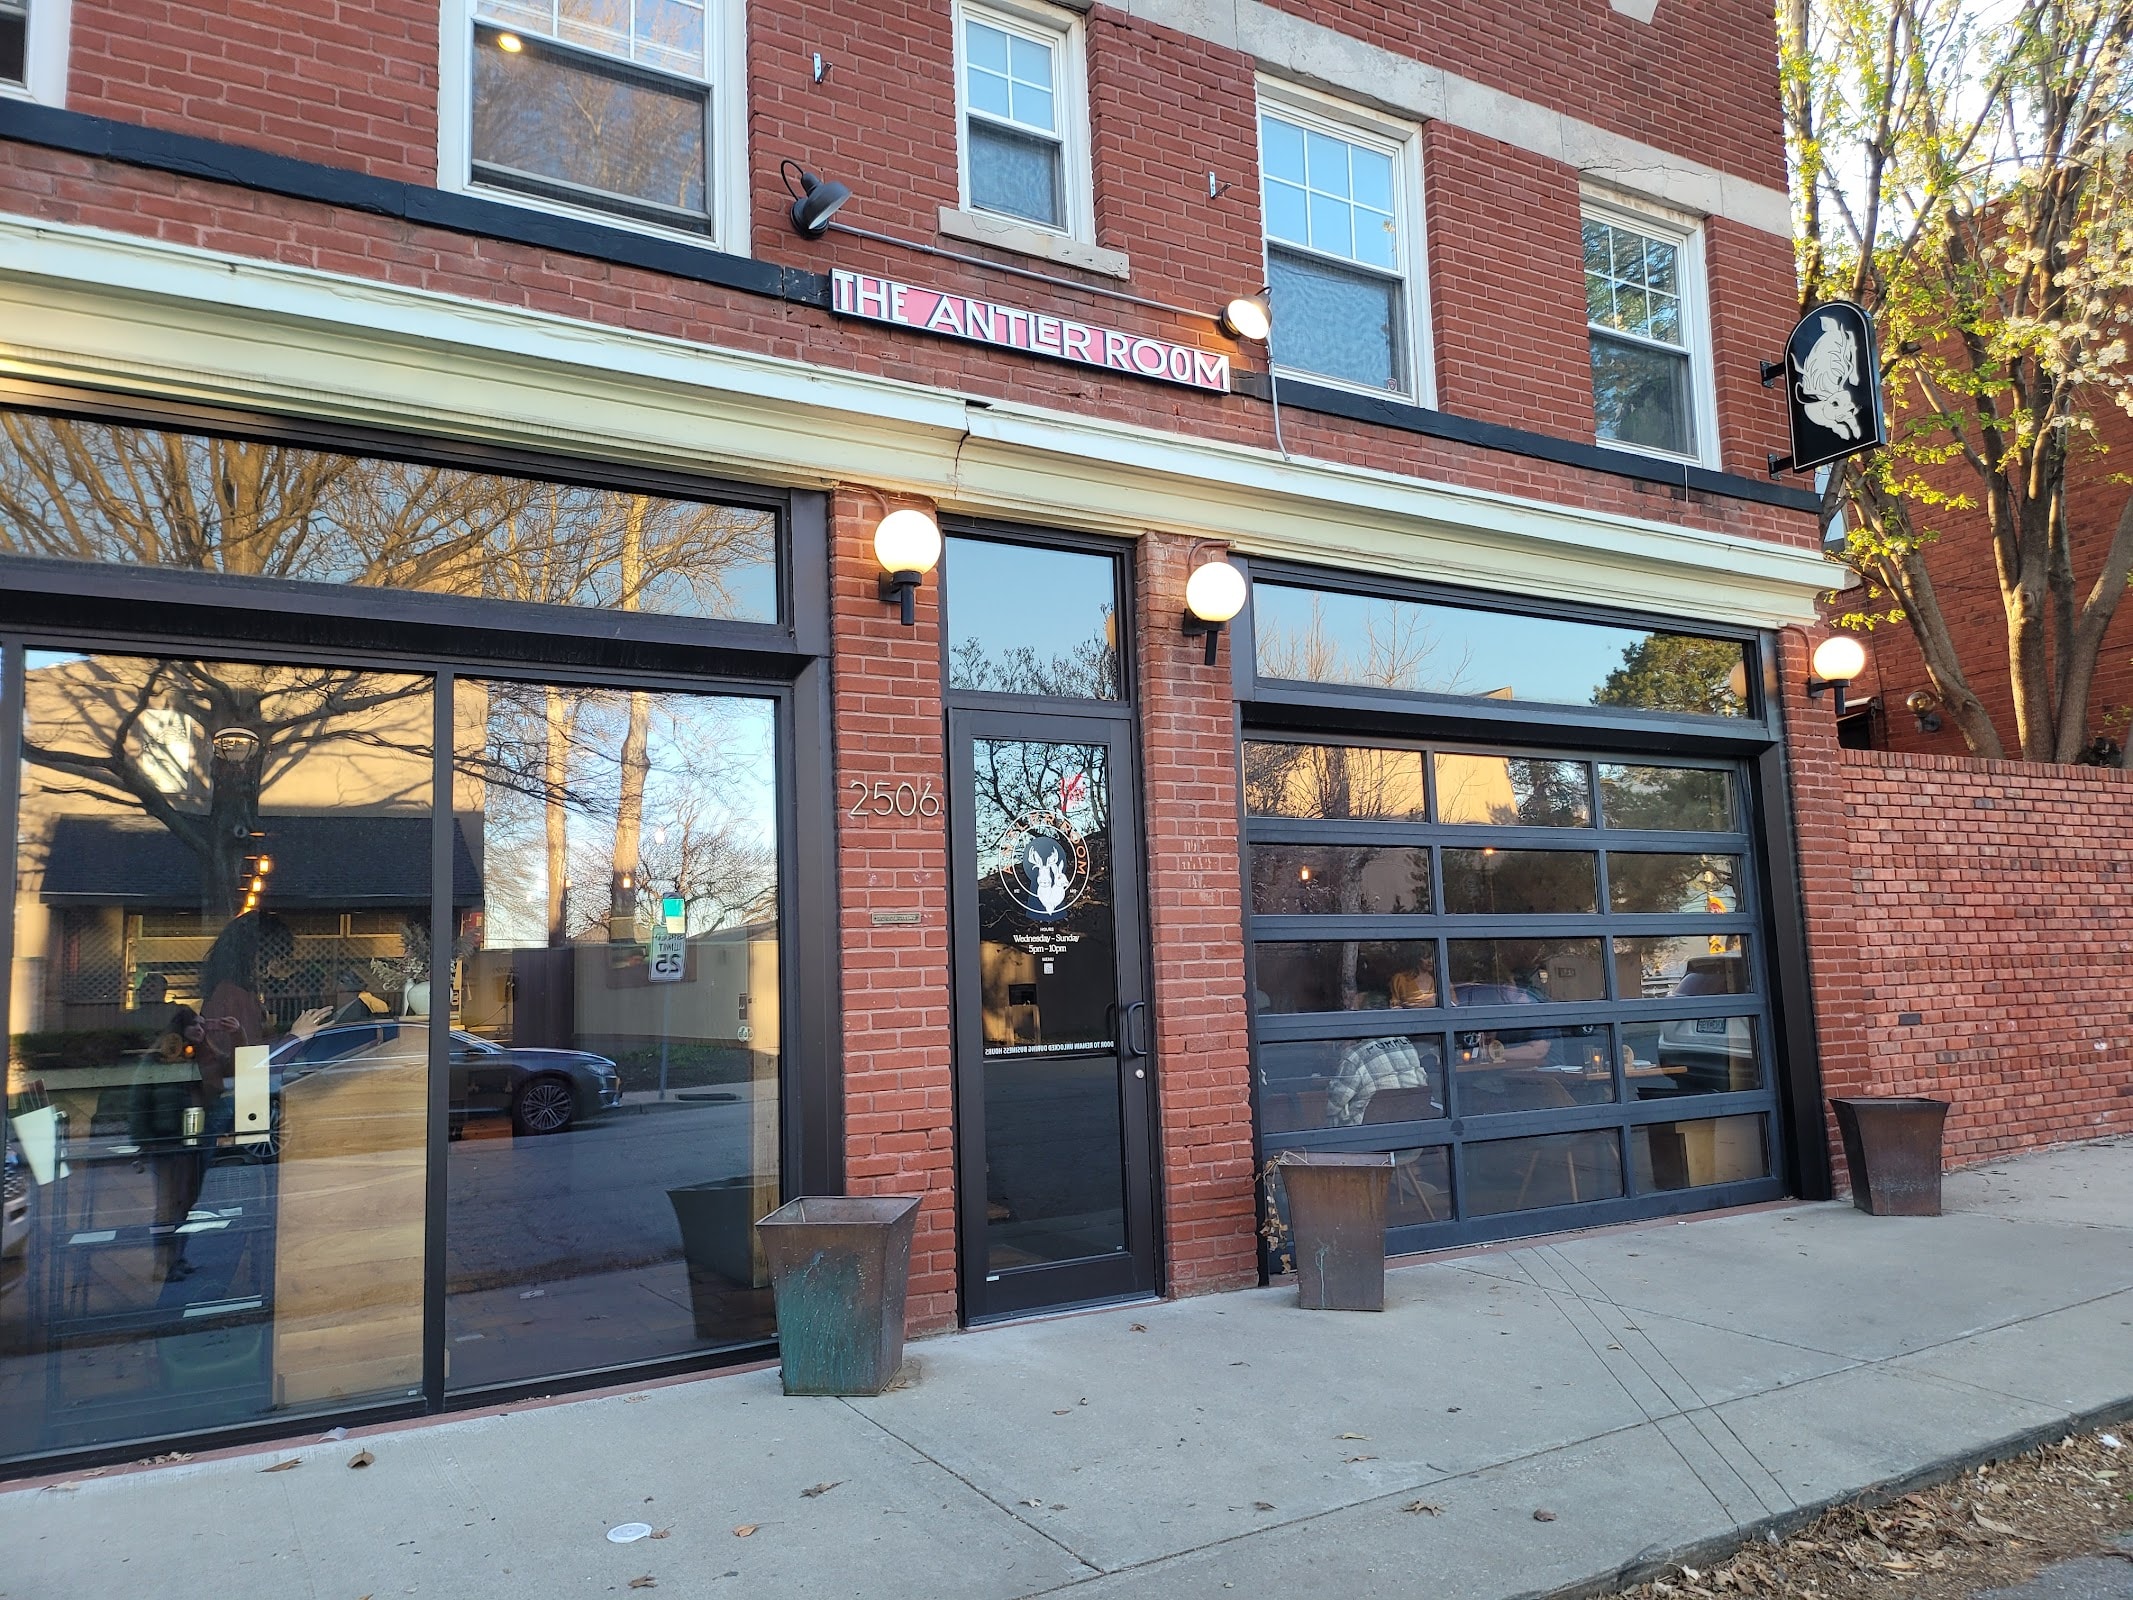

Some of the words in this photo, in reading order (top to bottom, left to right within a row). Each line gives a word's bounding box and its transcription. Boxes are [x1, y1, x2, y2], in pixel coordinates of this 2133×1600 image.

[834, 272, 909, 324] THE
[927, 294, 1093, 362] ANTLER
[1105, 331, 1230, 390] ROOM
[849, 781, 940, 817] 2506
[1061, 820, 1087, 875] ROOM
[1012, 934, 1051, 943] Wednesday
[1055, 933, 1080, 943] Sunday
[1028, 944, 1045, 954] 5pm
[1049, 944, 1067, 954] 10pm
